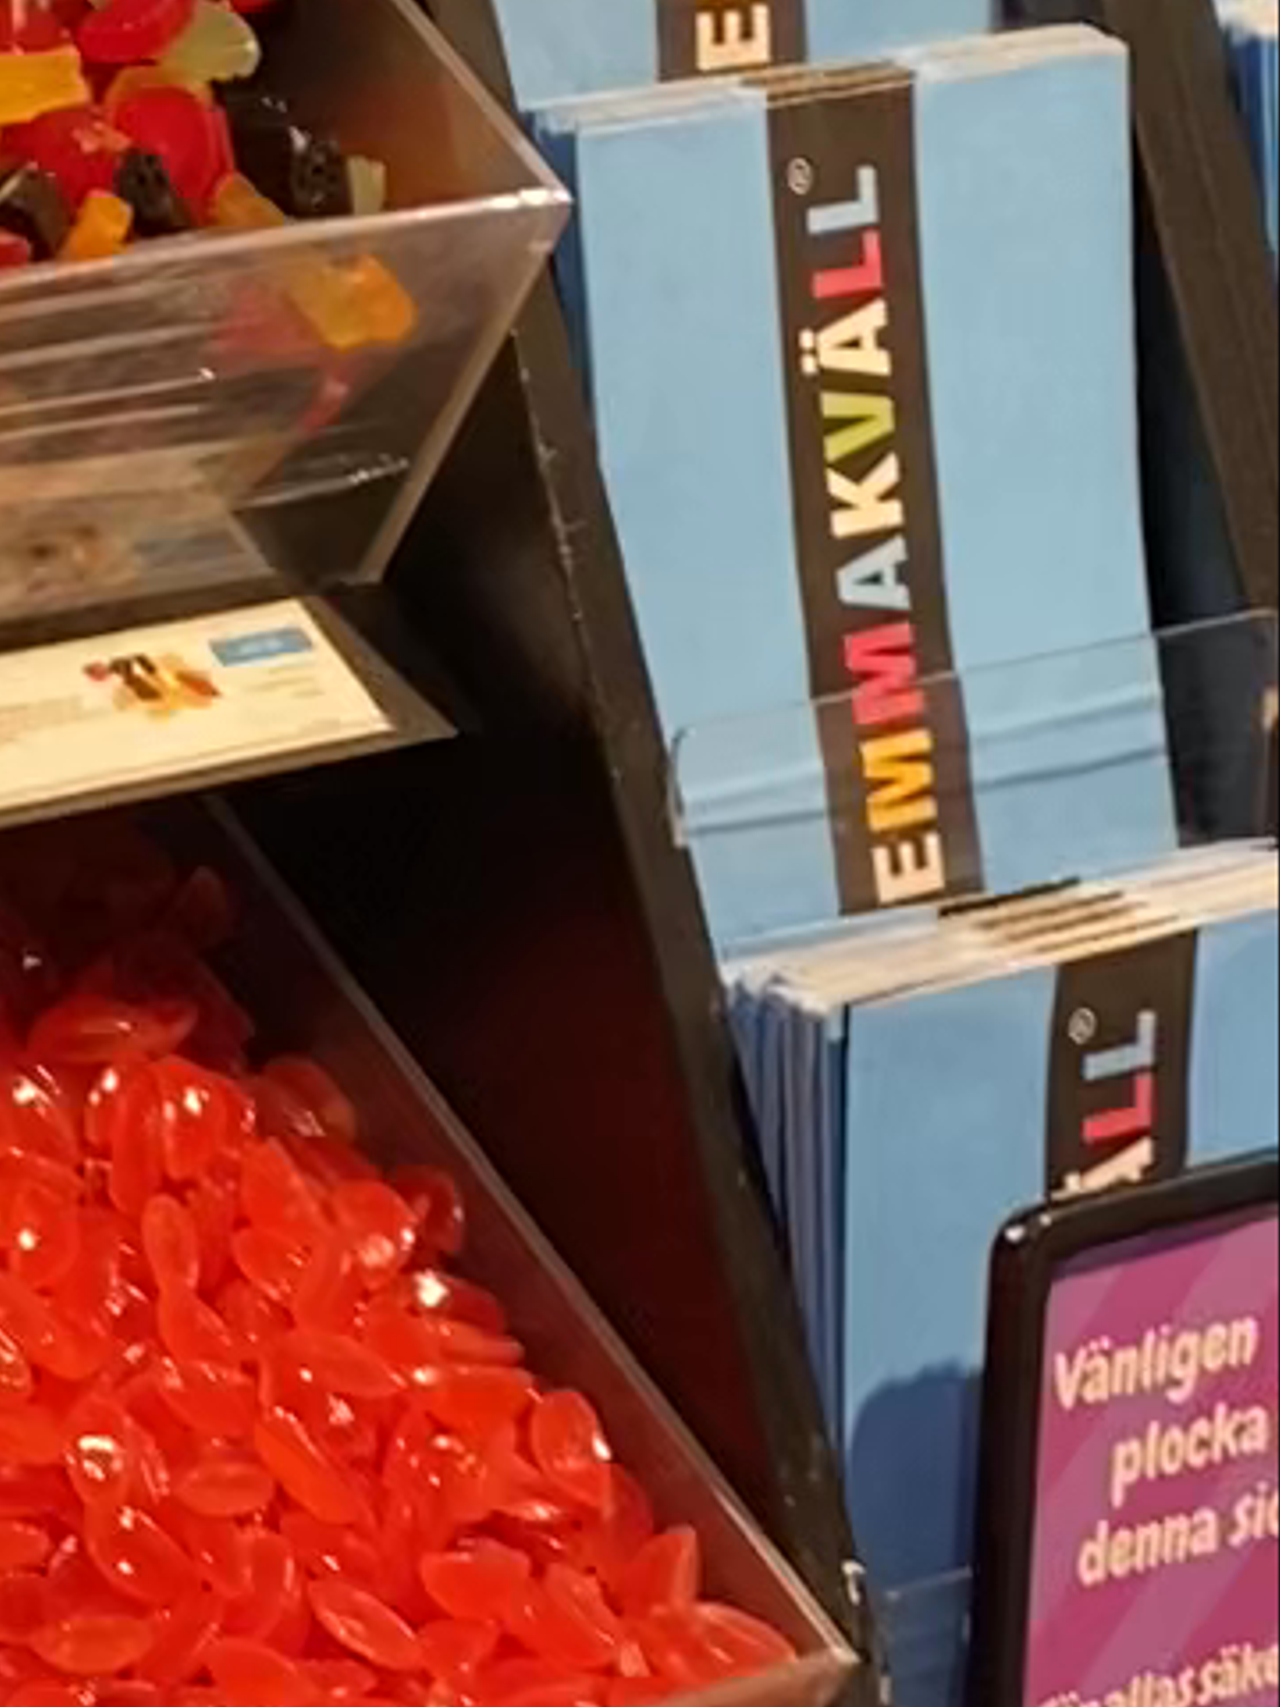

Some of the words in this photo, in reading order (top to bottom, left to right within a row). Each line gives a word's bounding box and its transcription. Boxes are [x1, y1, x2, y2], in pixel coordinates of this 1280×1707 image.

[799, 164, 946, 905] EMMAKVÄLL
[1055, 1316, 1258, 1410] Vänligen
[1111, 1401, 1269, 1504] plocka
[1078, 1506, 1219, 1588] denna
